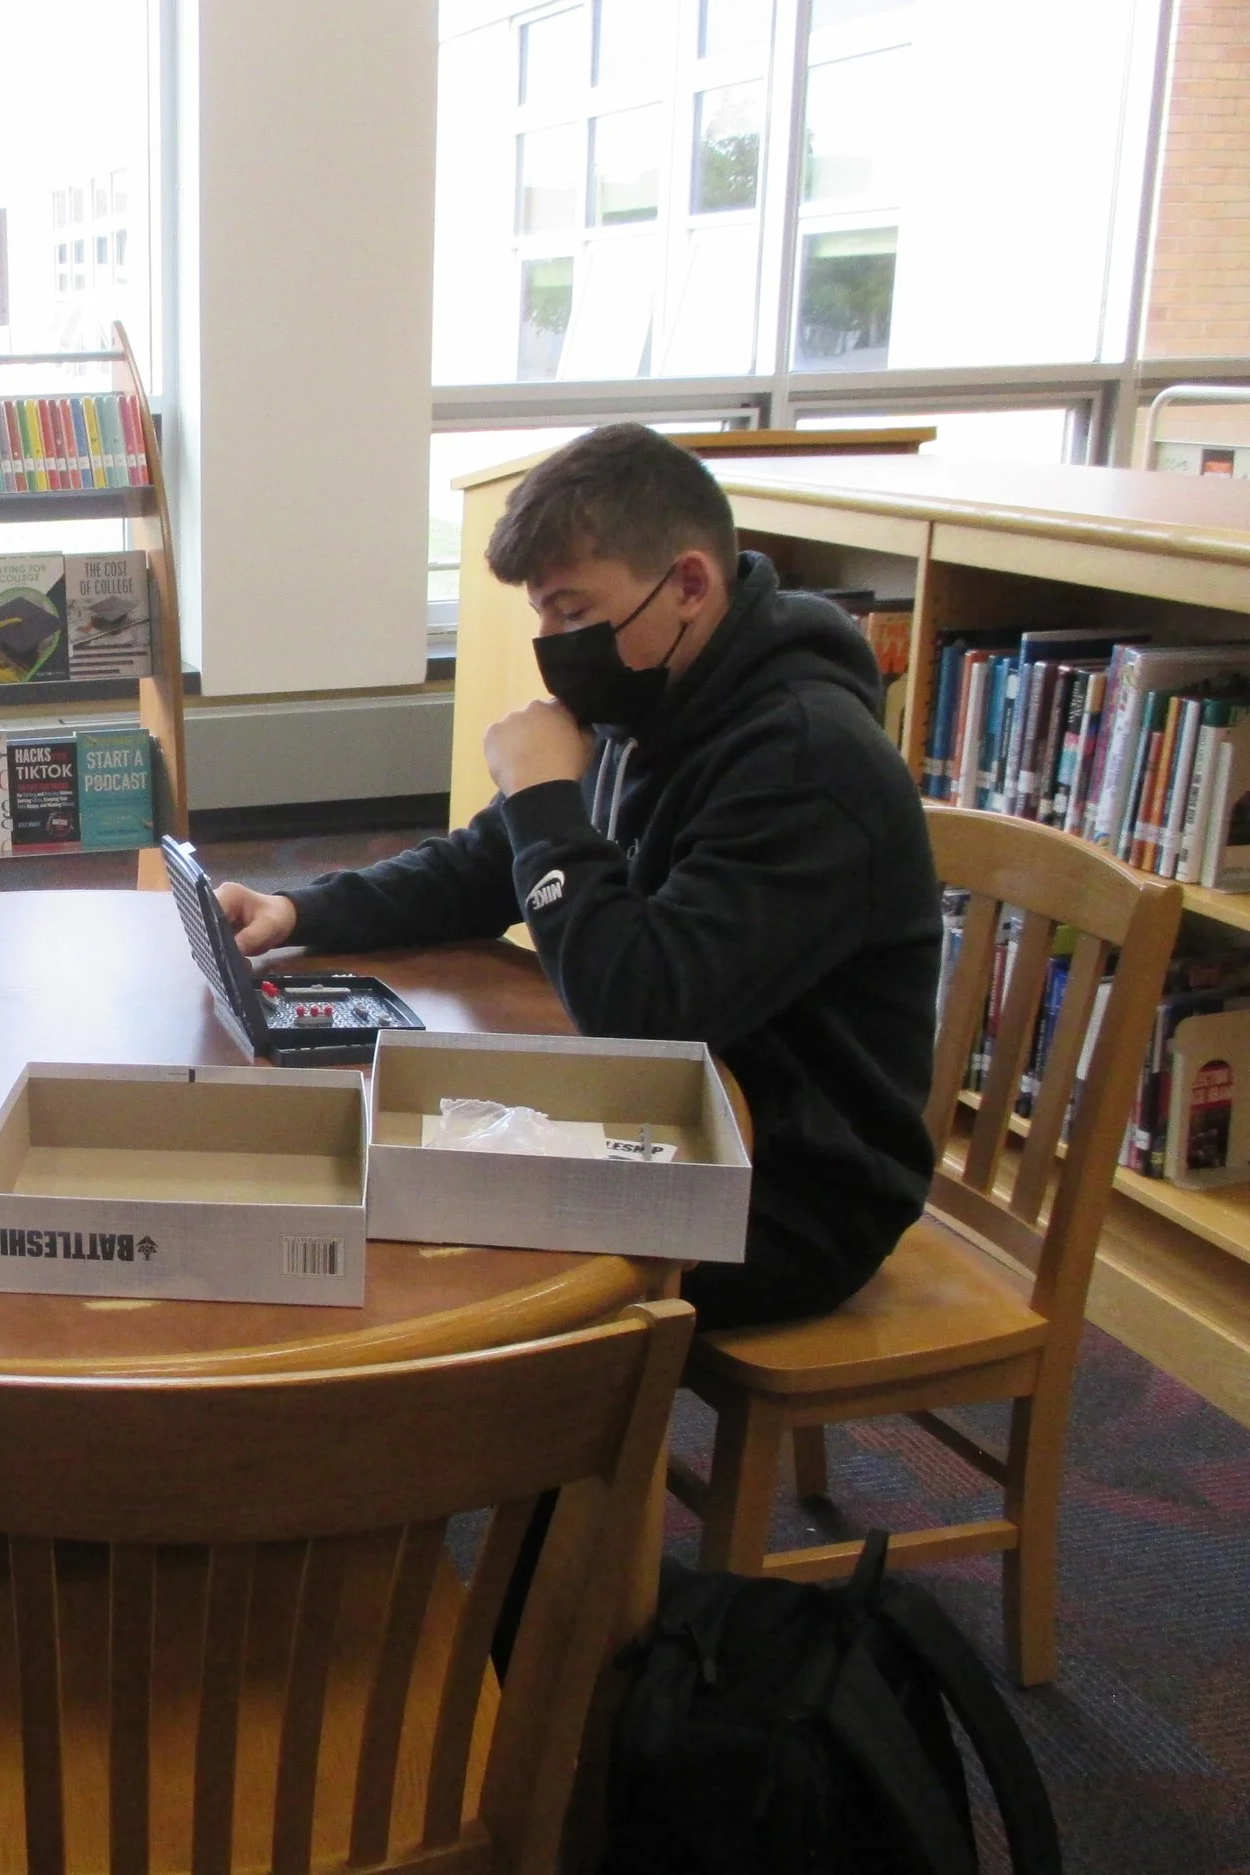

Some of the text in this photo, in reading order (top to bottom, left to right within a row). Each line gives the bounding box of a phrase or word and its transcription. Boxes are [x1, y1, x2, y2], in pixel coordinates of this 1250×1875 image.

[28, 564, 47, 573] FOR
[85, 560, 128, 578] THE COST
[79, 578, 134, 596] OF COLLEGE
[15, 747, 52, 764] HACKS
[86, 750, 129, 769] START
[134, 749, 144, 767] A
[15, 763, 73, 780] TIKTOK
[84, 772, 148, 793] PODCAST
[532, 882, 563, 910] NIKE
